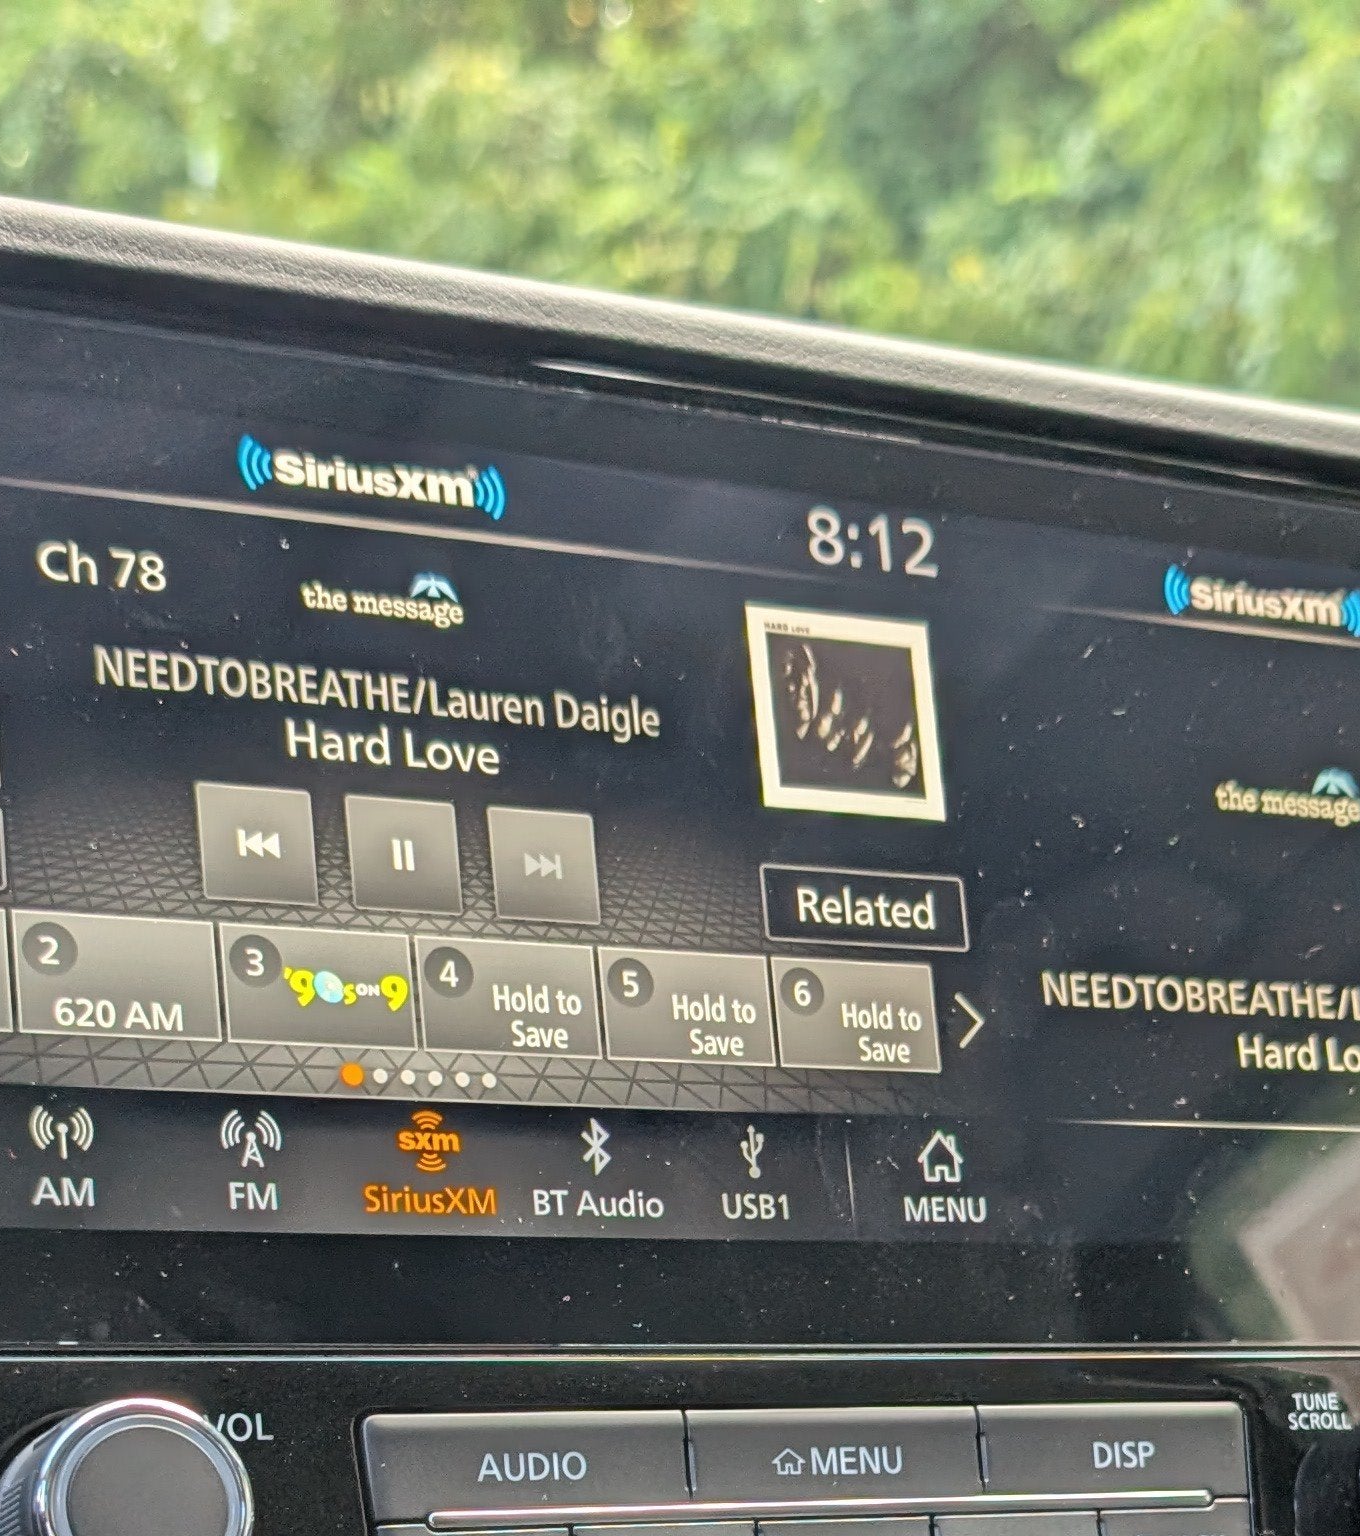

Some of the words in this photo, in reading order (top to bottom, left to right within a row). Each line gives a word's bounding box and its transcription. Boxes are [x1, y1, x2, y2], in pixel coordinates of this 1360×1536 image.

[807, 506, 938, 578] 8:12
[37, 541, 98, 587] Ch
[109, 550, 167, 592] 78
[301, 581, 348, 613] the
[352, 592, 464, 628] message
[94, 644, 546, 728] NEEDTOBREATHE/Lauren
[554, 690, 661, 743] Daigle
[285, 718, 392, 767] Hard
[405, 731, 501, 775] Love
[1215, 781, 1258, 813] the
[796, 886, 937, 931] Related
[39, 936, 61, 966] 2
[245, 948, 265, 976] 3
[440, 960, 459, 989] 4
[622, 969, 639, 998] 5
[380, 975, 409, 1012] 9
[492, 983, 551, 1015] Hold
[557, 989, 582, 1016] to
[793, 978, 812, 1007] 6
[54, 996, 117, 1030] 620
[125, 1001, 184, 1033] AM
[672, 993, 728, 1024] Hold
[732, 999, 757, 1025] to
[841, 1003, 894, 1032] Hold
[898, 1008, 922, 1033] to
[511, 1019, 569, 1051] Save
[688, 1028, 745, 1058] Save
[858, 1035, 911, 1064] Save
[1237, 1035, 1319, 1073] Hard
[32, 1177, 96, 1209] AM
[228, 1181, 279, 1212] FM
[363, 1184, 498, 1217] SiriusXM
[532, 1189, 569, 1217] BT
[576, 1190, 665, 1220] Audio
[721, 1193, 791, 1221] USB1
[903, 1196, 988, 1224] MENU
[1291, 1393, 1339, 1413] TUNE
[1288, 1411, 1352, 1432] SCROLL
[477, 1451, 588, 1484] AUDIO
[811, 1445, 904, 1477] MENU
[1092, 1440, 1156, 1470] DISP
